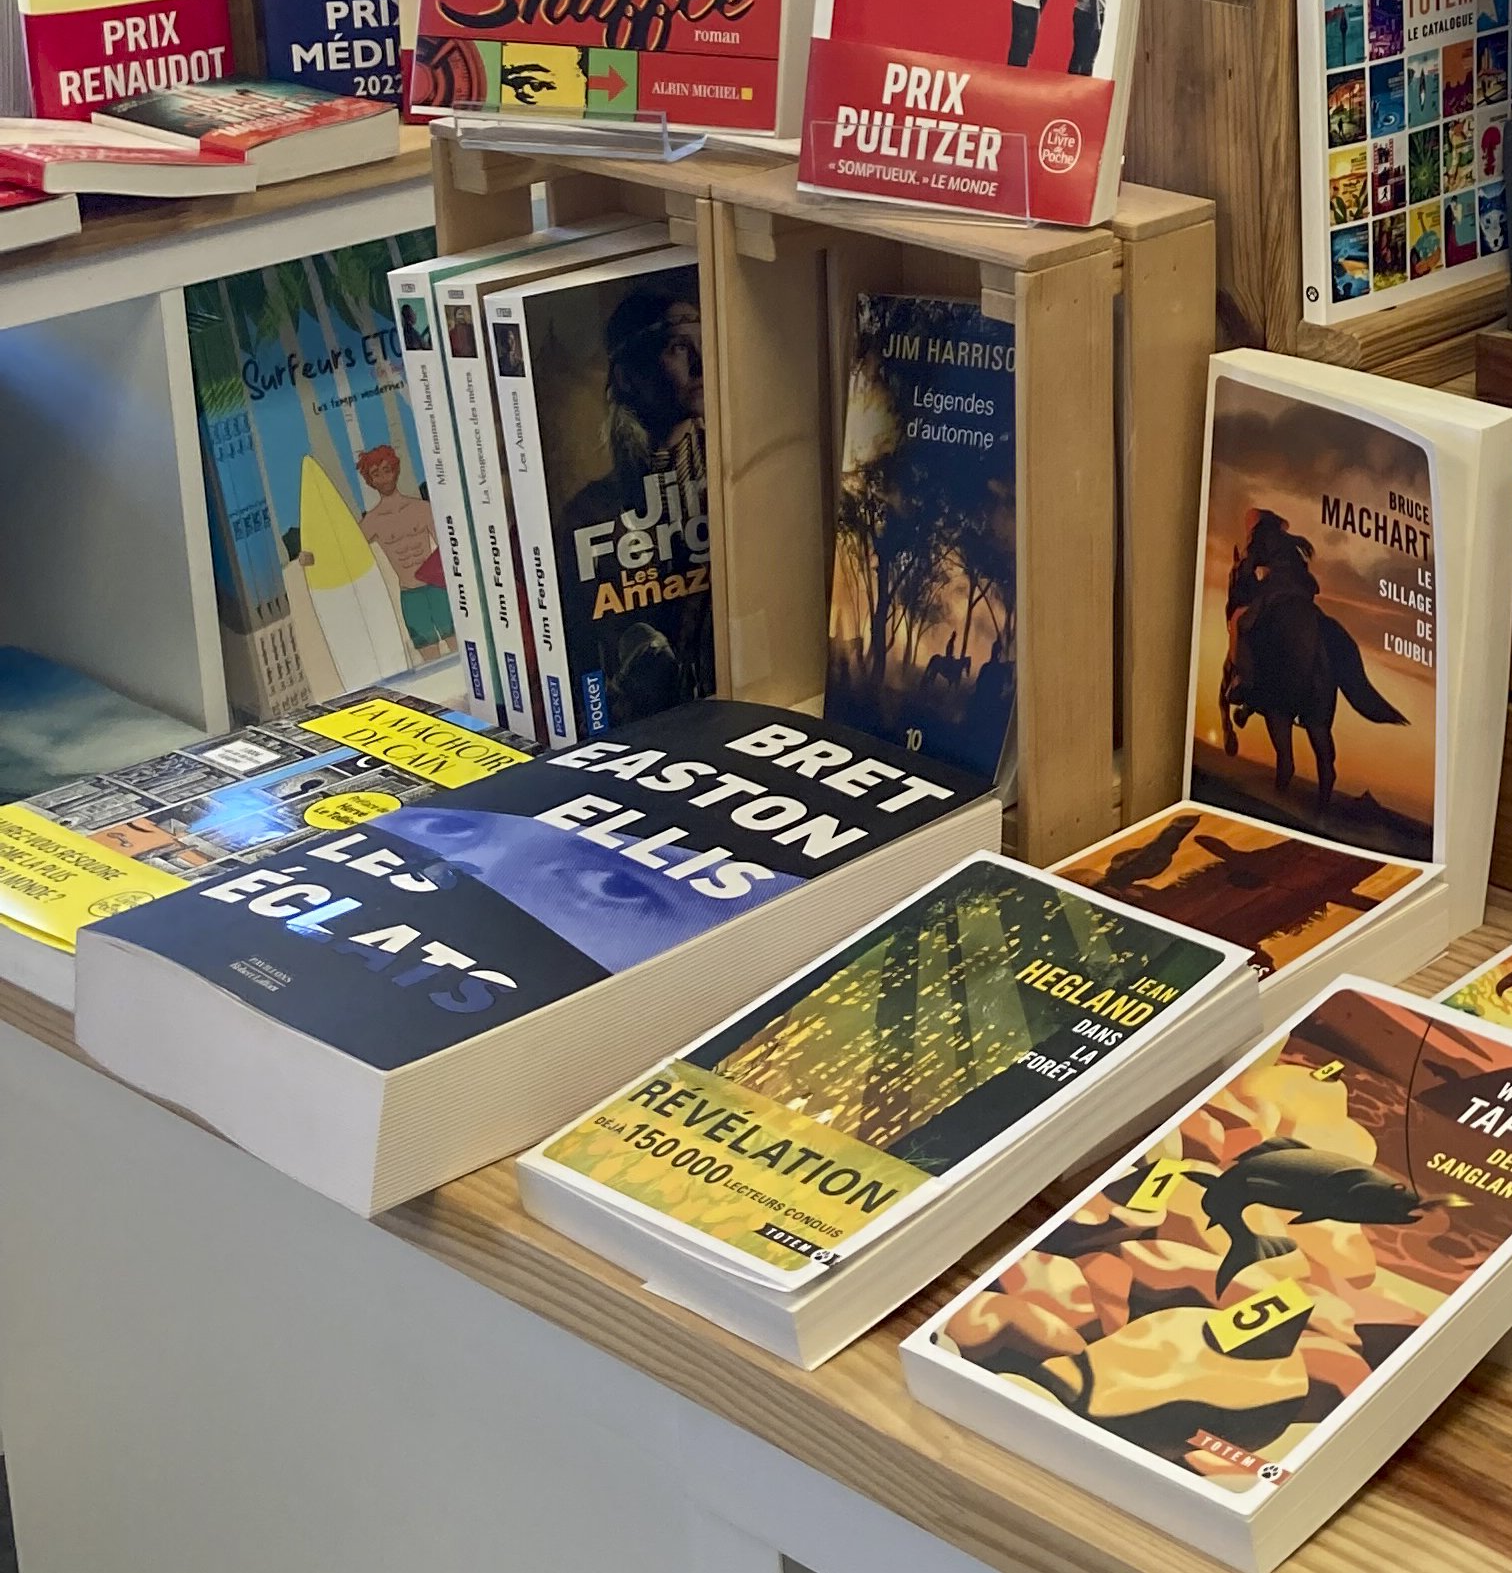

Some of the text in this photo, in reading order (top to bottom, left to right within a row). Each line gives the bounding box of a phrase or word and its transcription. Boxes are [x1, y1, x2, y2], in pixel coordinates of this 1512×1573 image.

[103, 11, 180, 56] PRIX
[694, 28, 740, 44] roman
[1408, 12, 1473, 41] LE CATALOGUE
[59, 46, 225, 106] RENAUDOT
[652, 82, 740, 100] ALBIN MICHEL
[882, 62, 970, 117] PRIX
[833, 106, 1001, 173] PULITZER
[913, 385, 994, 419] Légendes
[906, 418, 994, 449] d'automne
[1389, 490, 1430, 525] BRUCE
[1321, 495, 1432, 561] MACHART
[621, 568, 658, 588] Les
[1417, 569, 1432, 590] LE
[1379, 579, 1433, 617] SILLAGE
[1416, 620, 1433, 641] DE
[1383, 632, 1433, 668] L'OUBLI
[586, 677, 605, 730] POCKET
[725, 724, 955, 814] BRET
[546, 740, 869, 862] EASTON
[305, 831, 446, 893] LES
[532, 793, 777, 905] ELLIS
[199, 867, 518, 1016] ÉCLATS
[1016, 959, 1154, 1028] HEGLAND
[1128, 975, 1178, 1004] JEAN
[1072, 1018, 1124, 1047] DANS
[1018, 1047, 1076, 1084] FORÊT
[1070, 1044, 1099, 1066] LA
[628, 1079, 899, 1216] RÉVÉLATION
[1201, 1436, 1257, 1469] TOTEM
